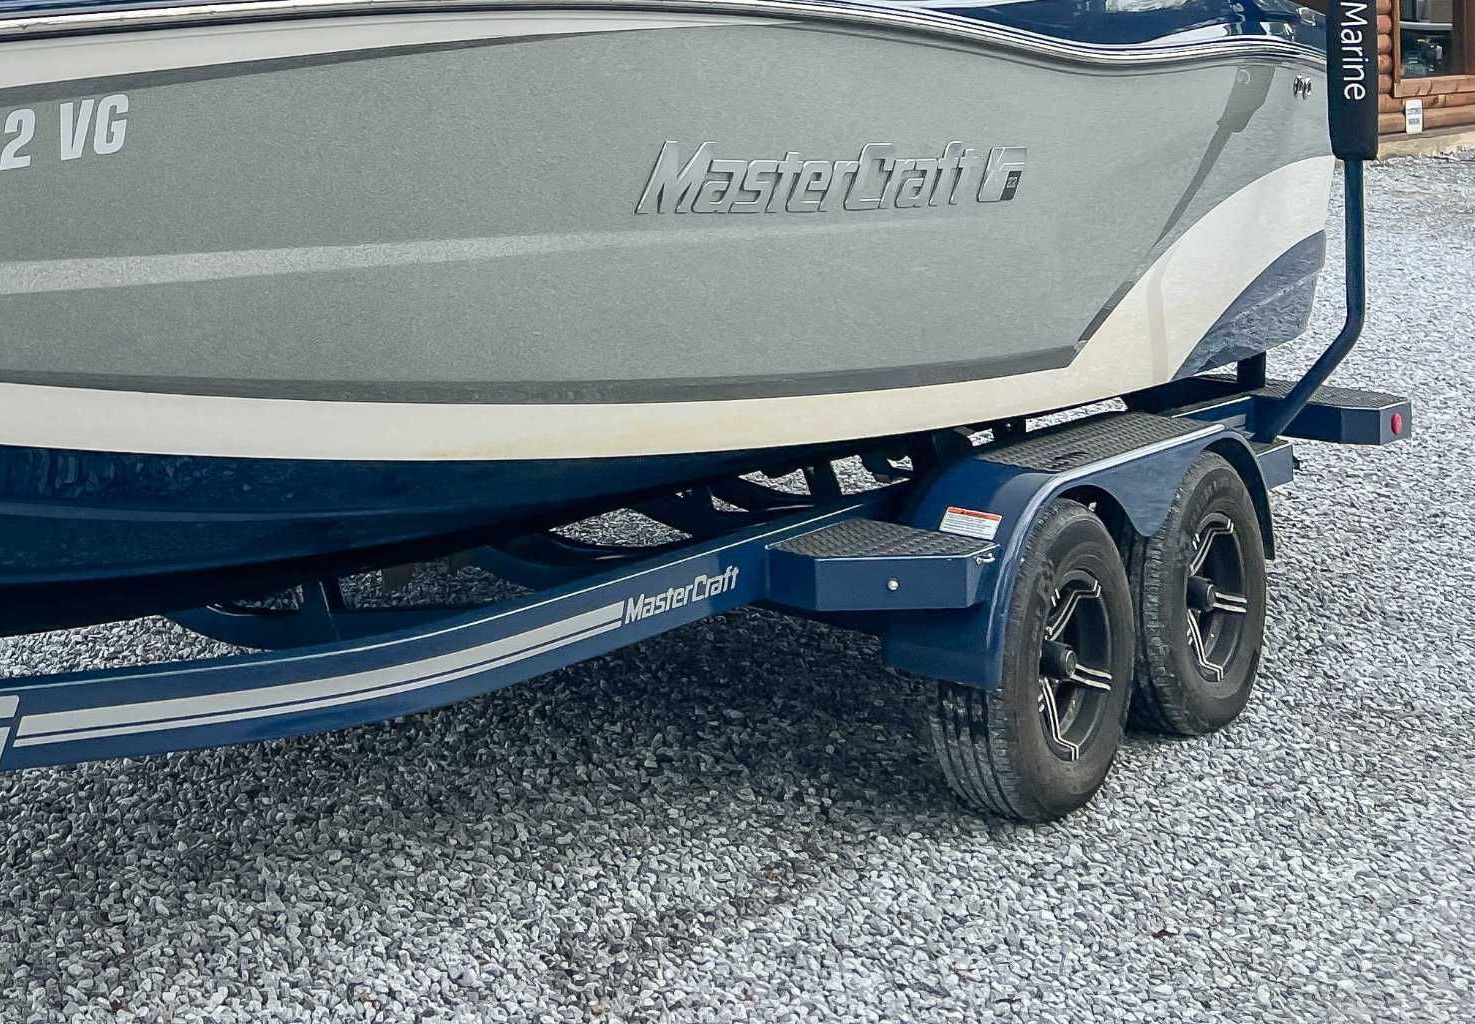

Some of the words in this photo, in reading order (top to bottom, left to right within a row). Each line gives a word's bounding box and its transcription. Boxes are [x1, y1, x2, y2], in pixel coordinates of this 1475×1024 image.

[1340, 3, 1370, 101] Marine
[59, 94, 128, 160] VG
[634, 139, 979, 215] MasterCraft
[625, 564, 739, 624] MasterCraft
